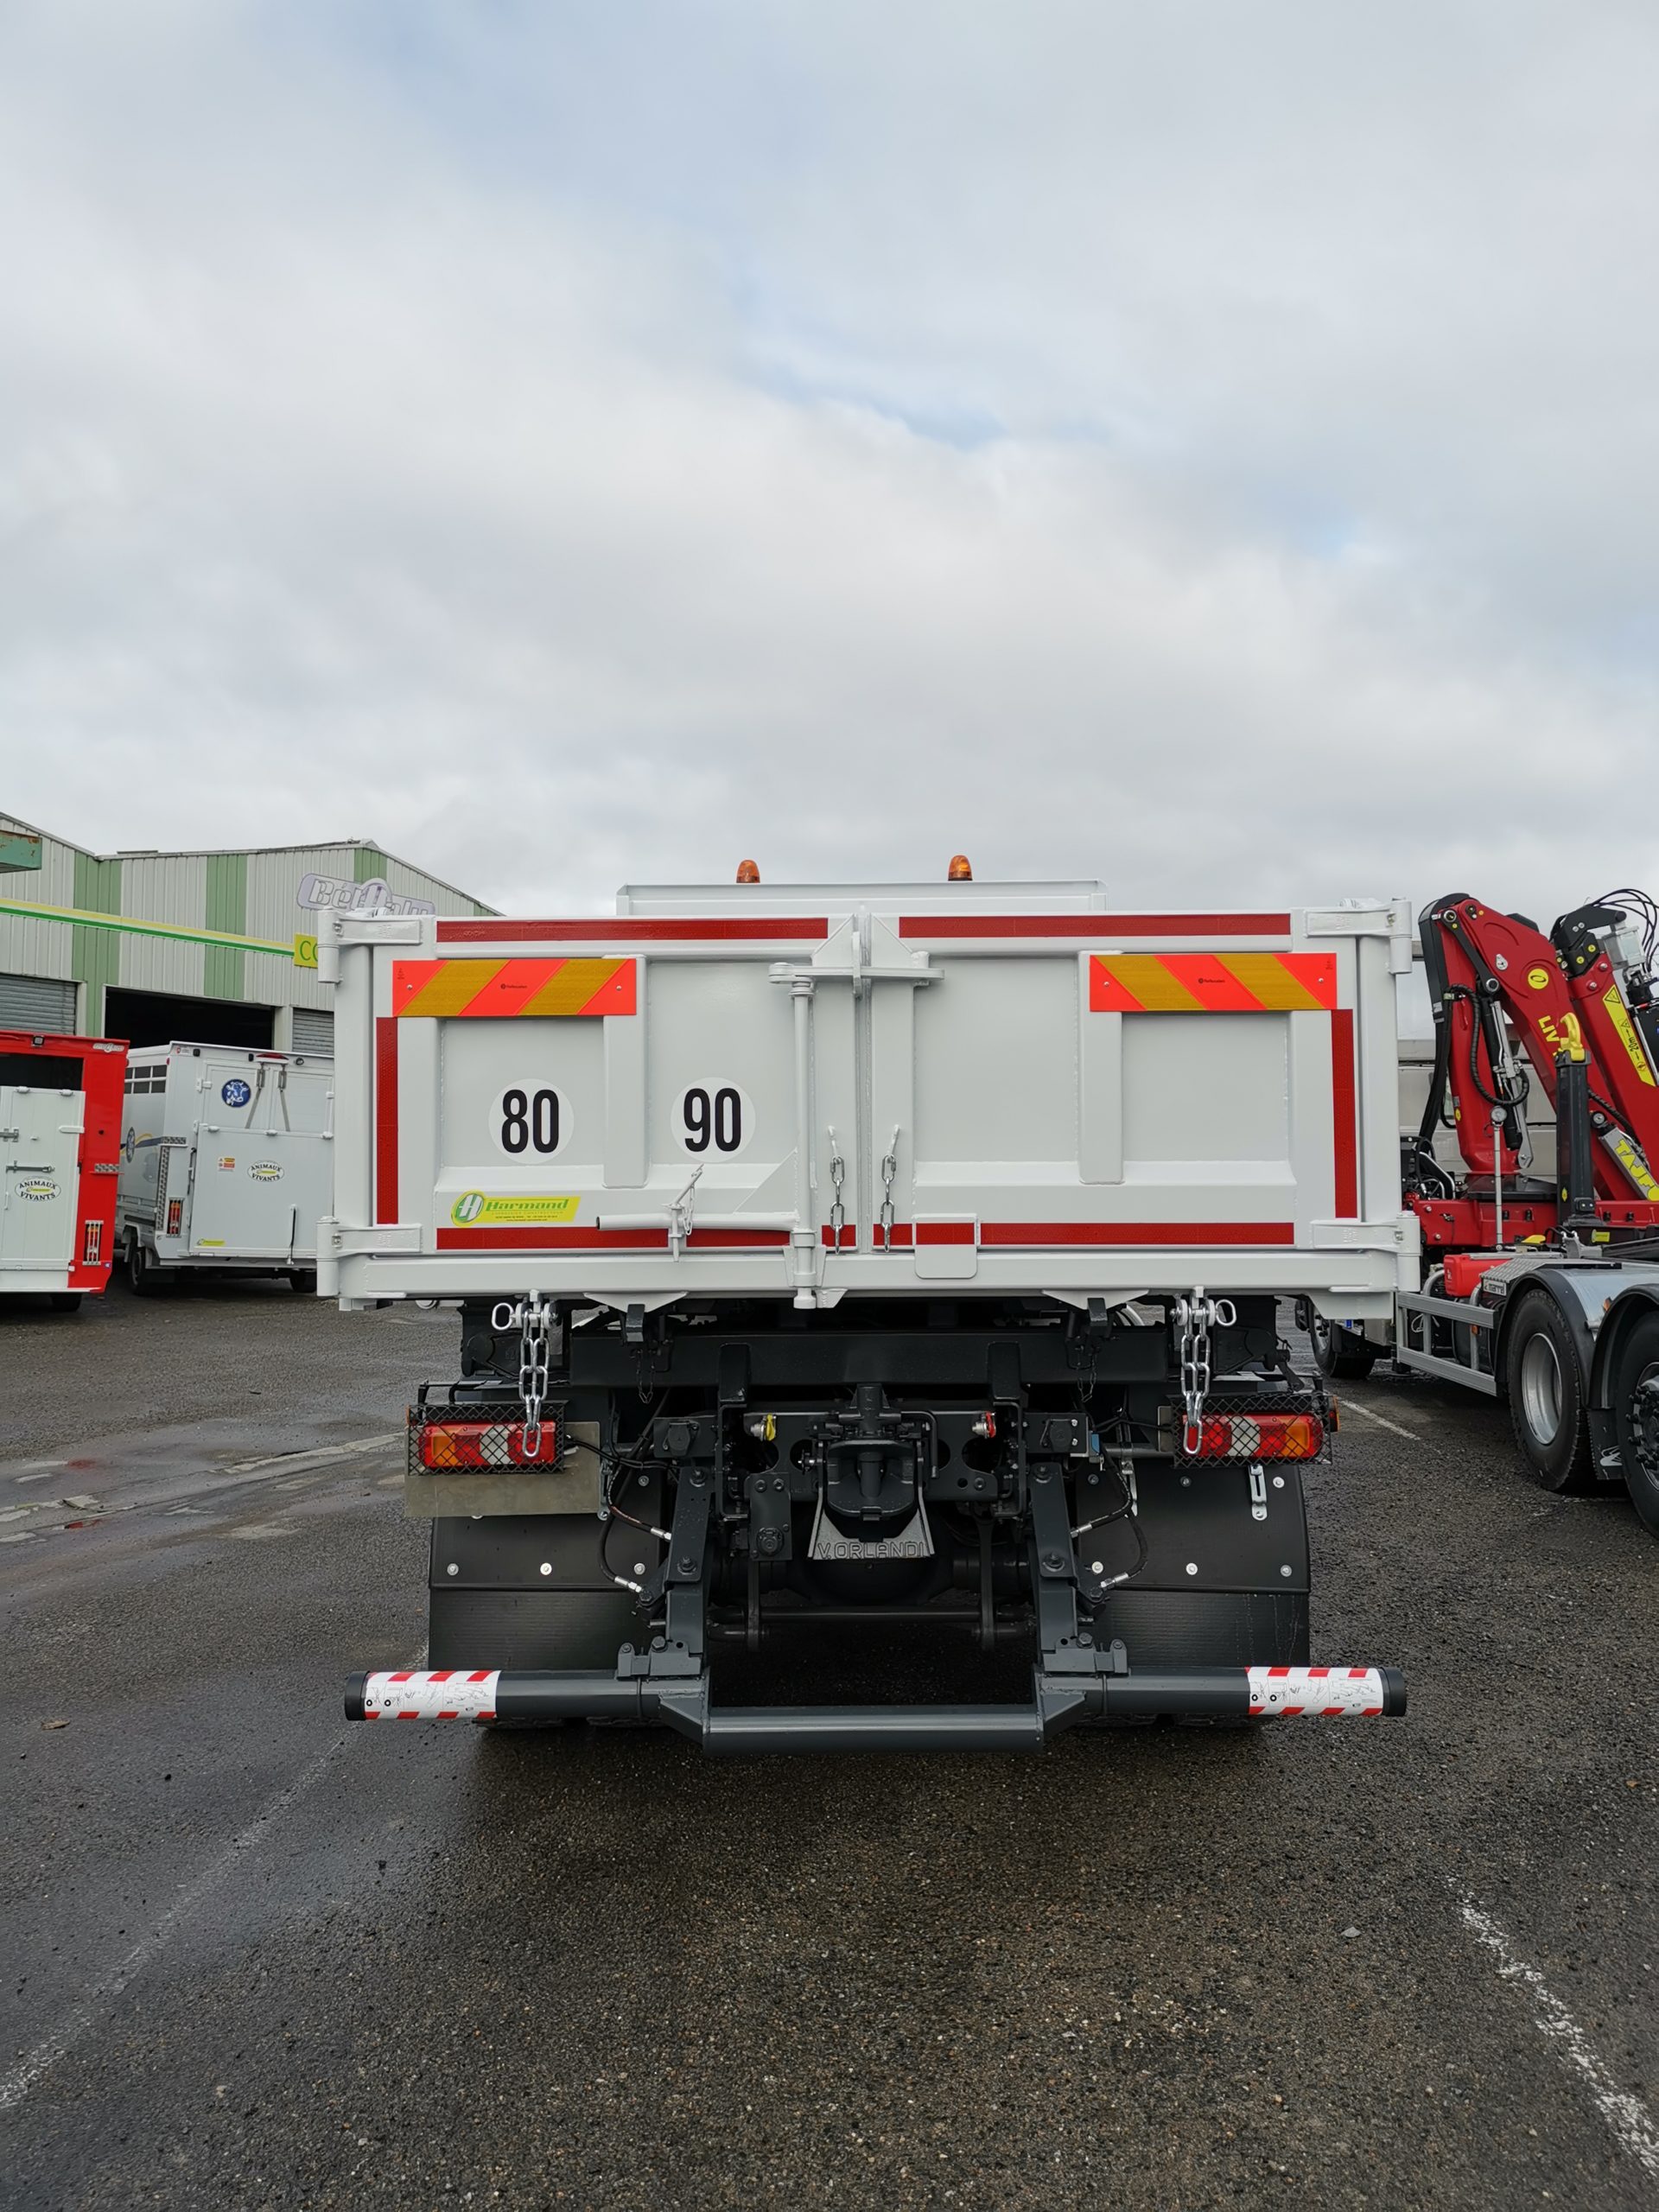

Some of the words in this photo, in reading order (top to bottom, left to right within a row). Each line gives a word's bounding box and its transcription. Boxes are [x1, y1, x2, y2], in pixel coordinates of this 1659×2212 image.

[300, 940, 318, 961] C
[502, 1090, 559, 1154] 80
[684, 1088, 741, 1153] 90
[251, 1163, 282, 1172] ANIMAUX
[251, 1173, 281, 1182] VIVANTS
[19, 1180, 56, 1190] ANIMAUX
[21, 1192, 56, 1200] VIVANTS
[486, 1198, 569, 1211] Harmand
